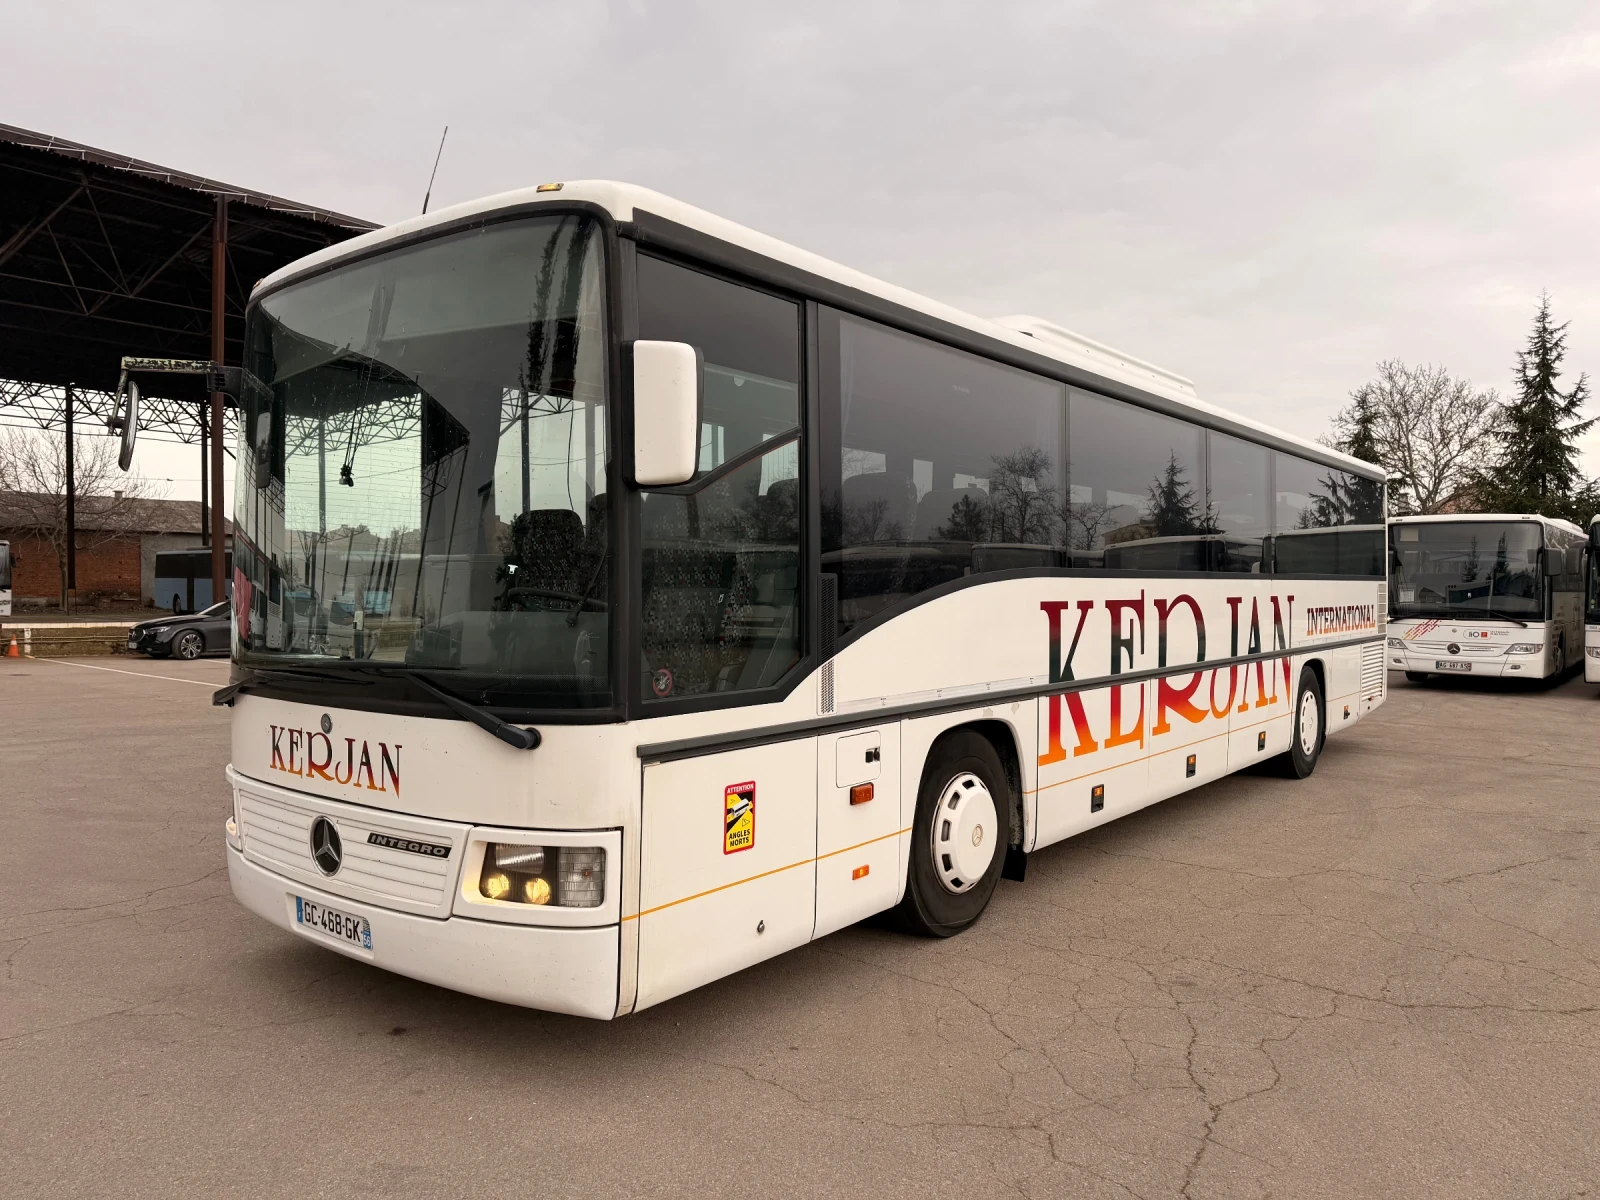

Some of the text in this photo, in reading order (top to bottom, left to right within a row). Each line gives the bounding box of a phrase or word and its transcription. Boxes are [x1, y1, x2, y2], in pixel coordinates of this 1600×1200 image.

[1307, 604, 1376, 636] INTERNATIONAL
[1038, 589, 1294, 766] KERJAN
[268, 724, 403, 799] KERJAN
[727, 783, 754, 793] ATTENTION
[370, 834, 446, 856] INTEGRO
[729, 829, 750, 840] ANGLES
[730, 837, 749, 847] MORTS
[304, 901, 361, 943] GC-468-GK
[363, 935, 371, 947] 56
